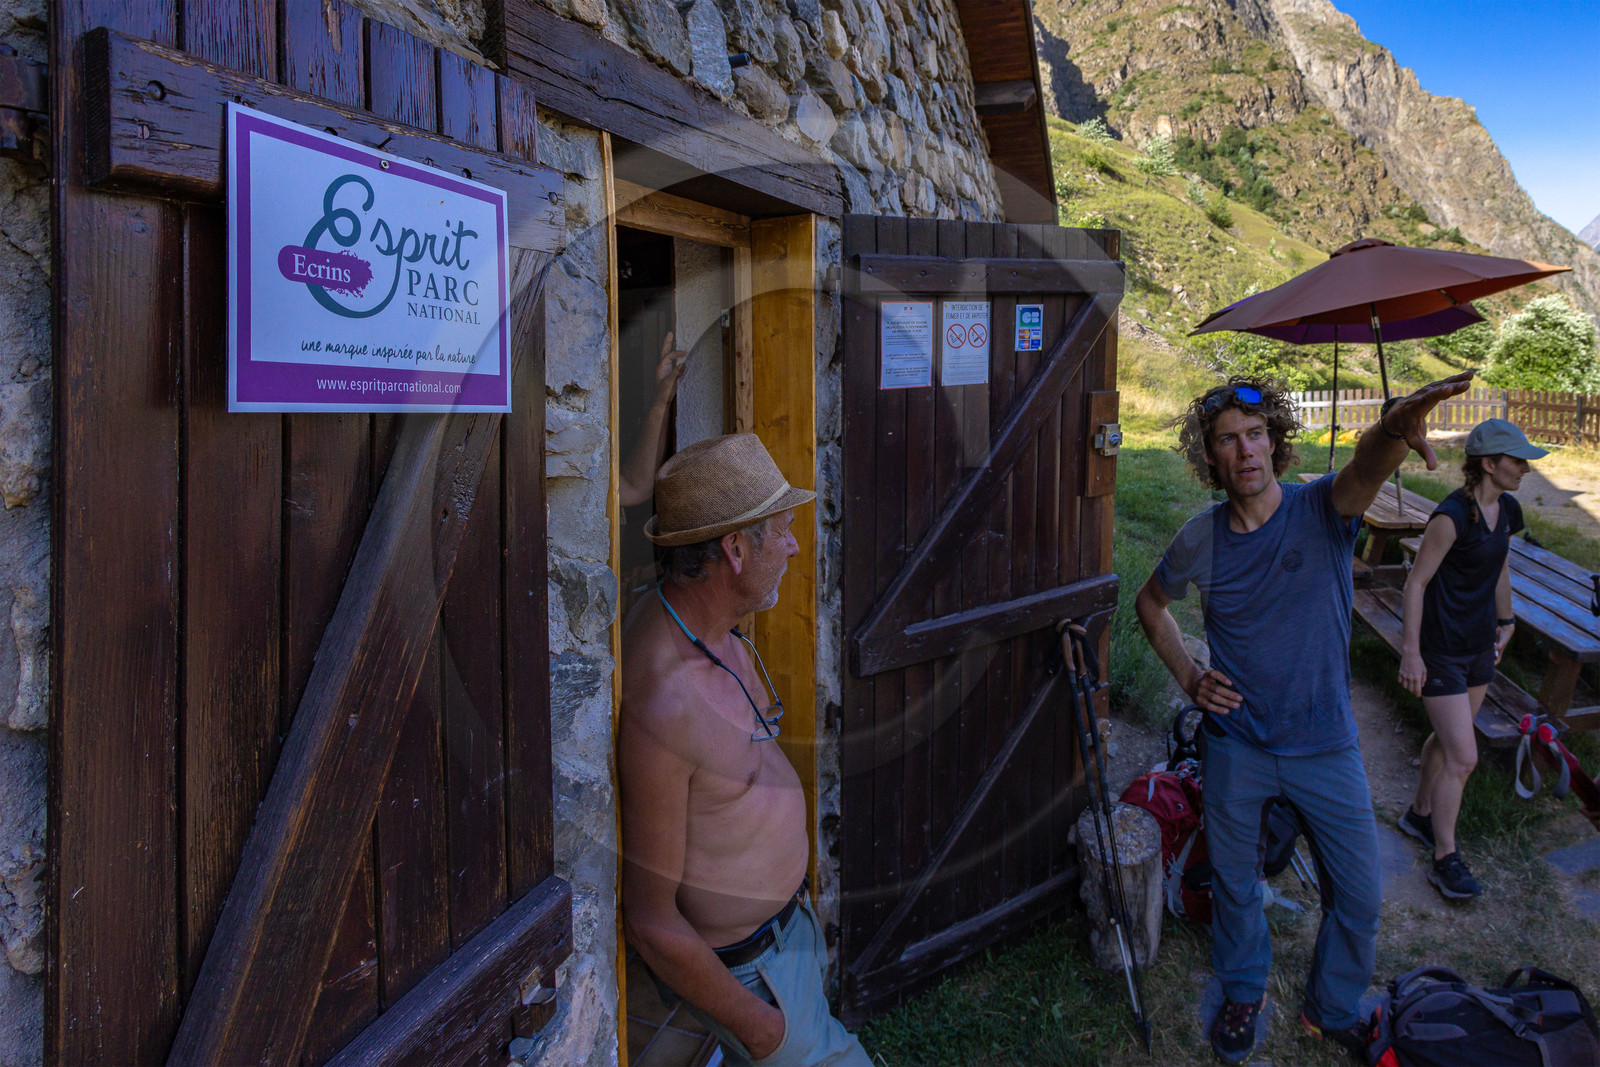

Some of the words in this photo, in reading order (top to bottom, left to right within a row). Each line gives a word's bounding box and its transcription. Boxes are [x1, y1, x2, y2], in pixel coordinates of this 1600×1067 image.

[302, 173, 478, 319] Esprit
[292, 252, 351, 283] Ecrins
[407, 268, 480, 306] PARC
[407, 302, 481, 325] NATIONAL
[945, 312, 959, 320] FUMER
[959, 312, 965, 320] ET
[965, 312, 971, 320] DE
[971, 312, 989, 320] VAPOTER
[951, 303, 978, 311] INTERDICTION
[978, 303, 984, 311] DE
[301, 340, 322, 352] une
[324, 342, 368, 360] marque
[371, 343, 414, 363] inspirée
[415, 350, 434, 365] par
[434, 345, 446, 361] la
[447, 348, 476, 365] nature
[316, 378, 462, 395] www.espritparcnational.com
